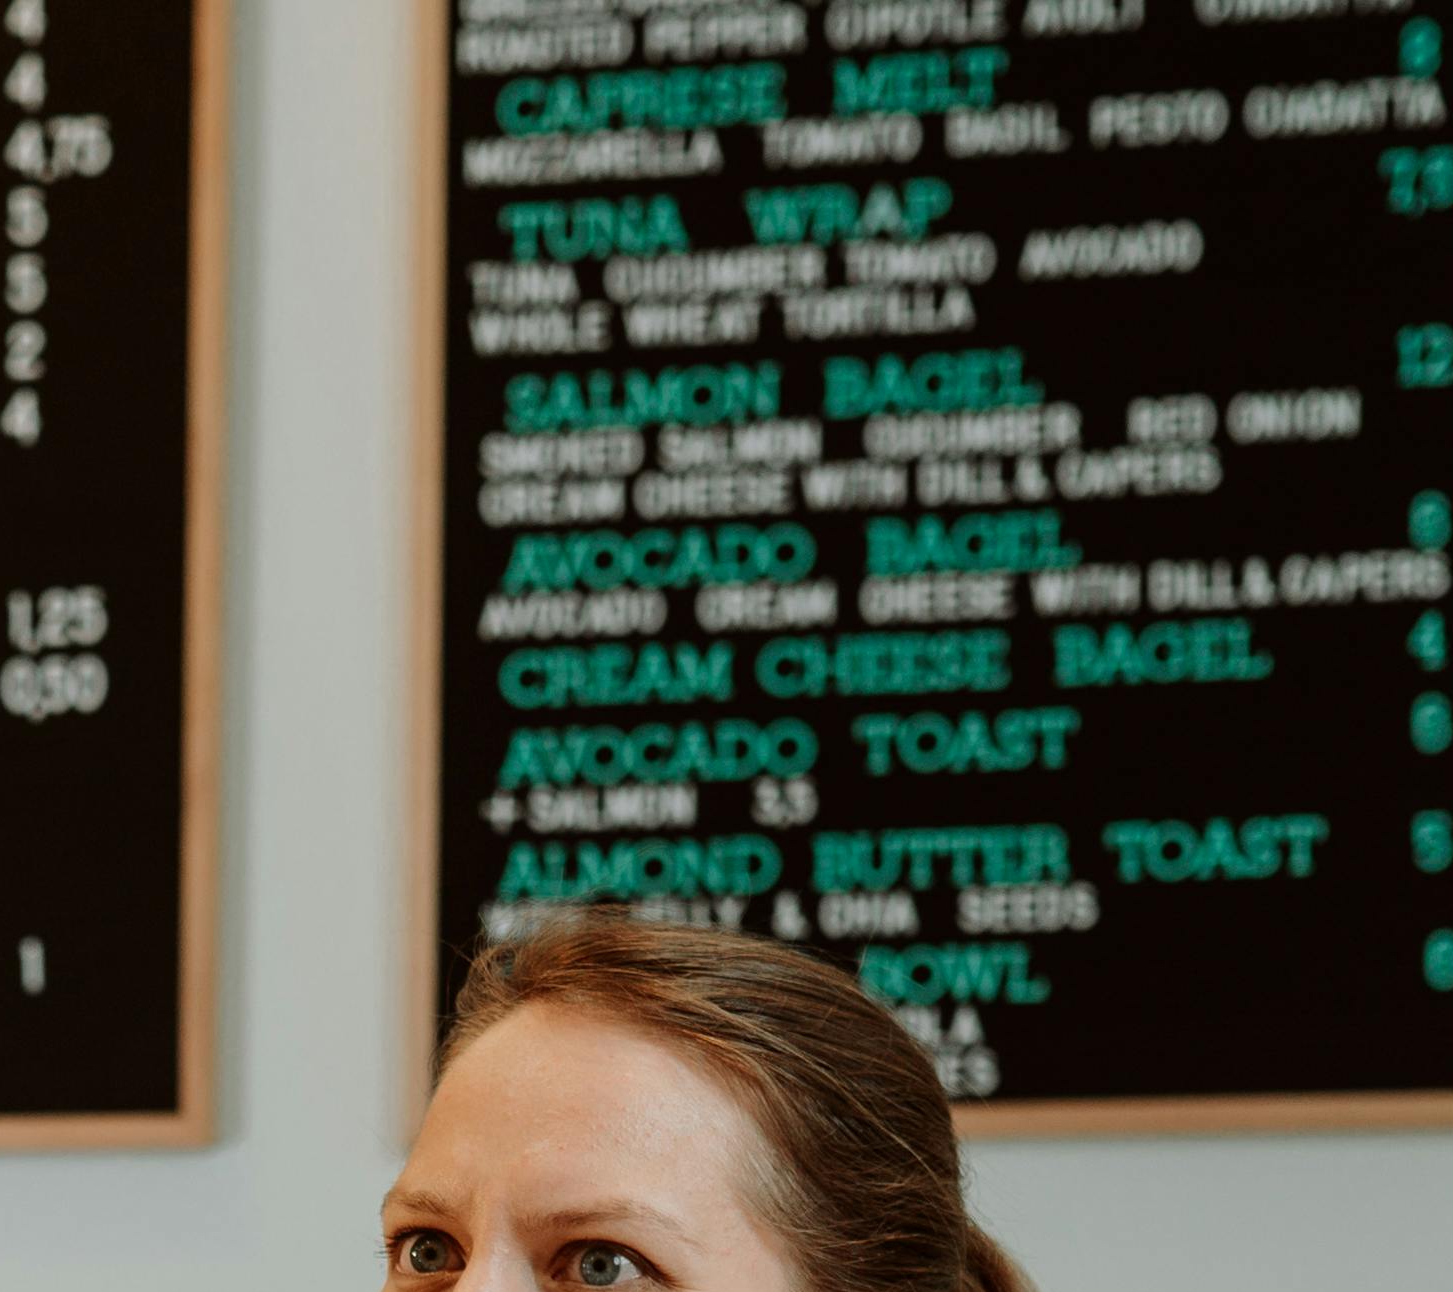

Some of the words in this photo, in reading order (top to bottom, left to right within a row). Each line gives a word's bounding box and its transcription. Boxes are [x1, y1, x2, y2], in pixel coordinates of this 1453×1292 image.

[8, 55, 45, 109] 4
[498, 64, 784, 133] CAPRESE
[834, 48, 1007, 113] MELT
[8, 188, 45, 243] 5
[499, 197, 687, 260] TUNA
[748, 180, 949, 243] WRAP
[1021, 221, 1201, 280] AVOCADO
[8, 255, 45, 310] 5
[8, 323, 43, 377] 2
[471, 305, 610, 353] WHOLE
[624, 296, 758, 346] WHEAT
[4, 391, 39, 443] 4
[506, 363, 779, 430] SALMON
[825, 348, 1042, 417] BAGEL
[1229, 389, 1359, 442] ONION
[635, 471, 791, 518] CHEESE
[916, 454, 1007, 501] DILL
[1058, 447, 1220, 497] CAPERS
[504, 523, 814, 591] AVOCADO
[868, 512, 1080, 575] BAGEL
[480, 589, 664, 638] AVOCADO
[697, 580, 834, 630] CREAM
[860, 572, 1014, 623] CHEESE
[1033, 566, 1138, 614] WITH
[1151, 562, 1235, 609] DILL
[1281, 550, 1448, 604] CAPERS
[501, 644, 730, 706] CREAM
[757, 631, 1009, 696] CHEESE
[1056, 620, 1271, 685] BAGEL
[1409, 613, 1444, 669] 4
[502, 720, 817, 786] AVOCADO
[855, 709, 1079, 773] TOAST
[529, 787, 695, 828] SALMON
[501, 837, 779, 897] ALMOND
[815, 828, 1068, 890] BUTTER
[1106, 816, 1328, 880] TOAST
[1413, 812, 1451, 870] 5
[959, 883, 1097, 930] SEEDS
